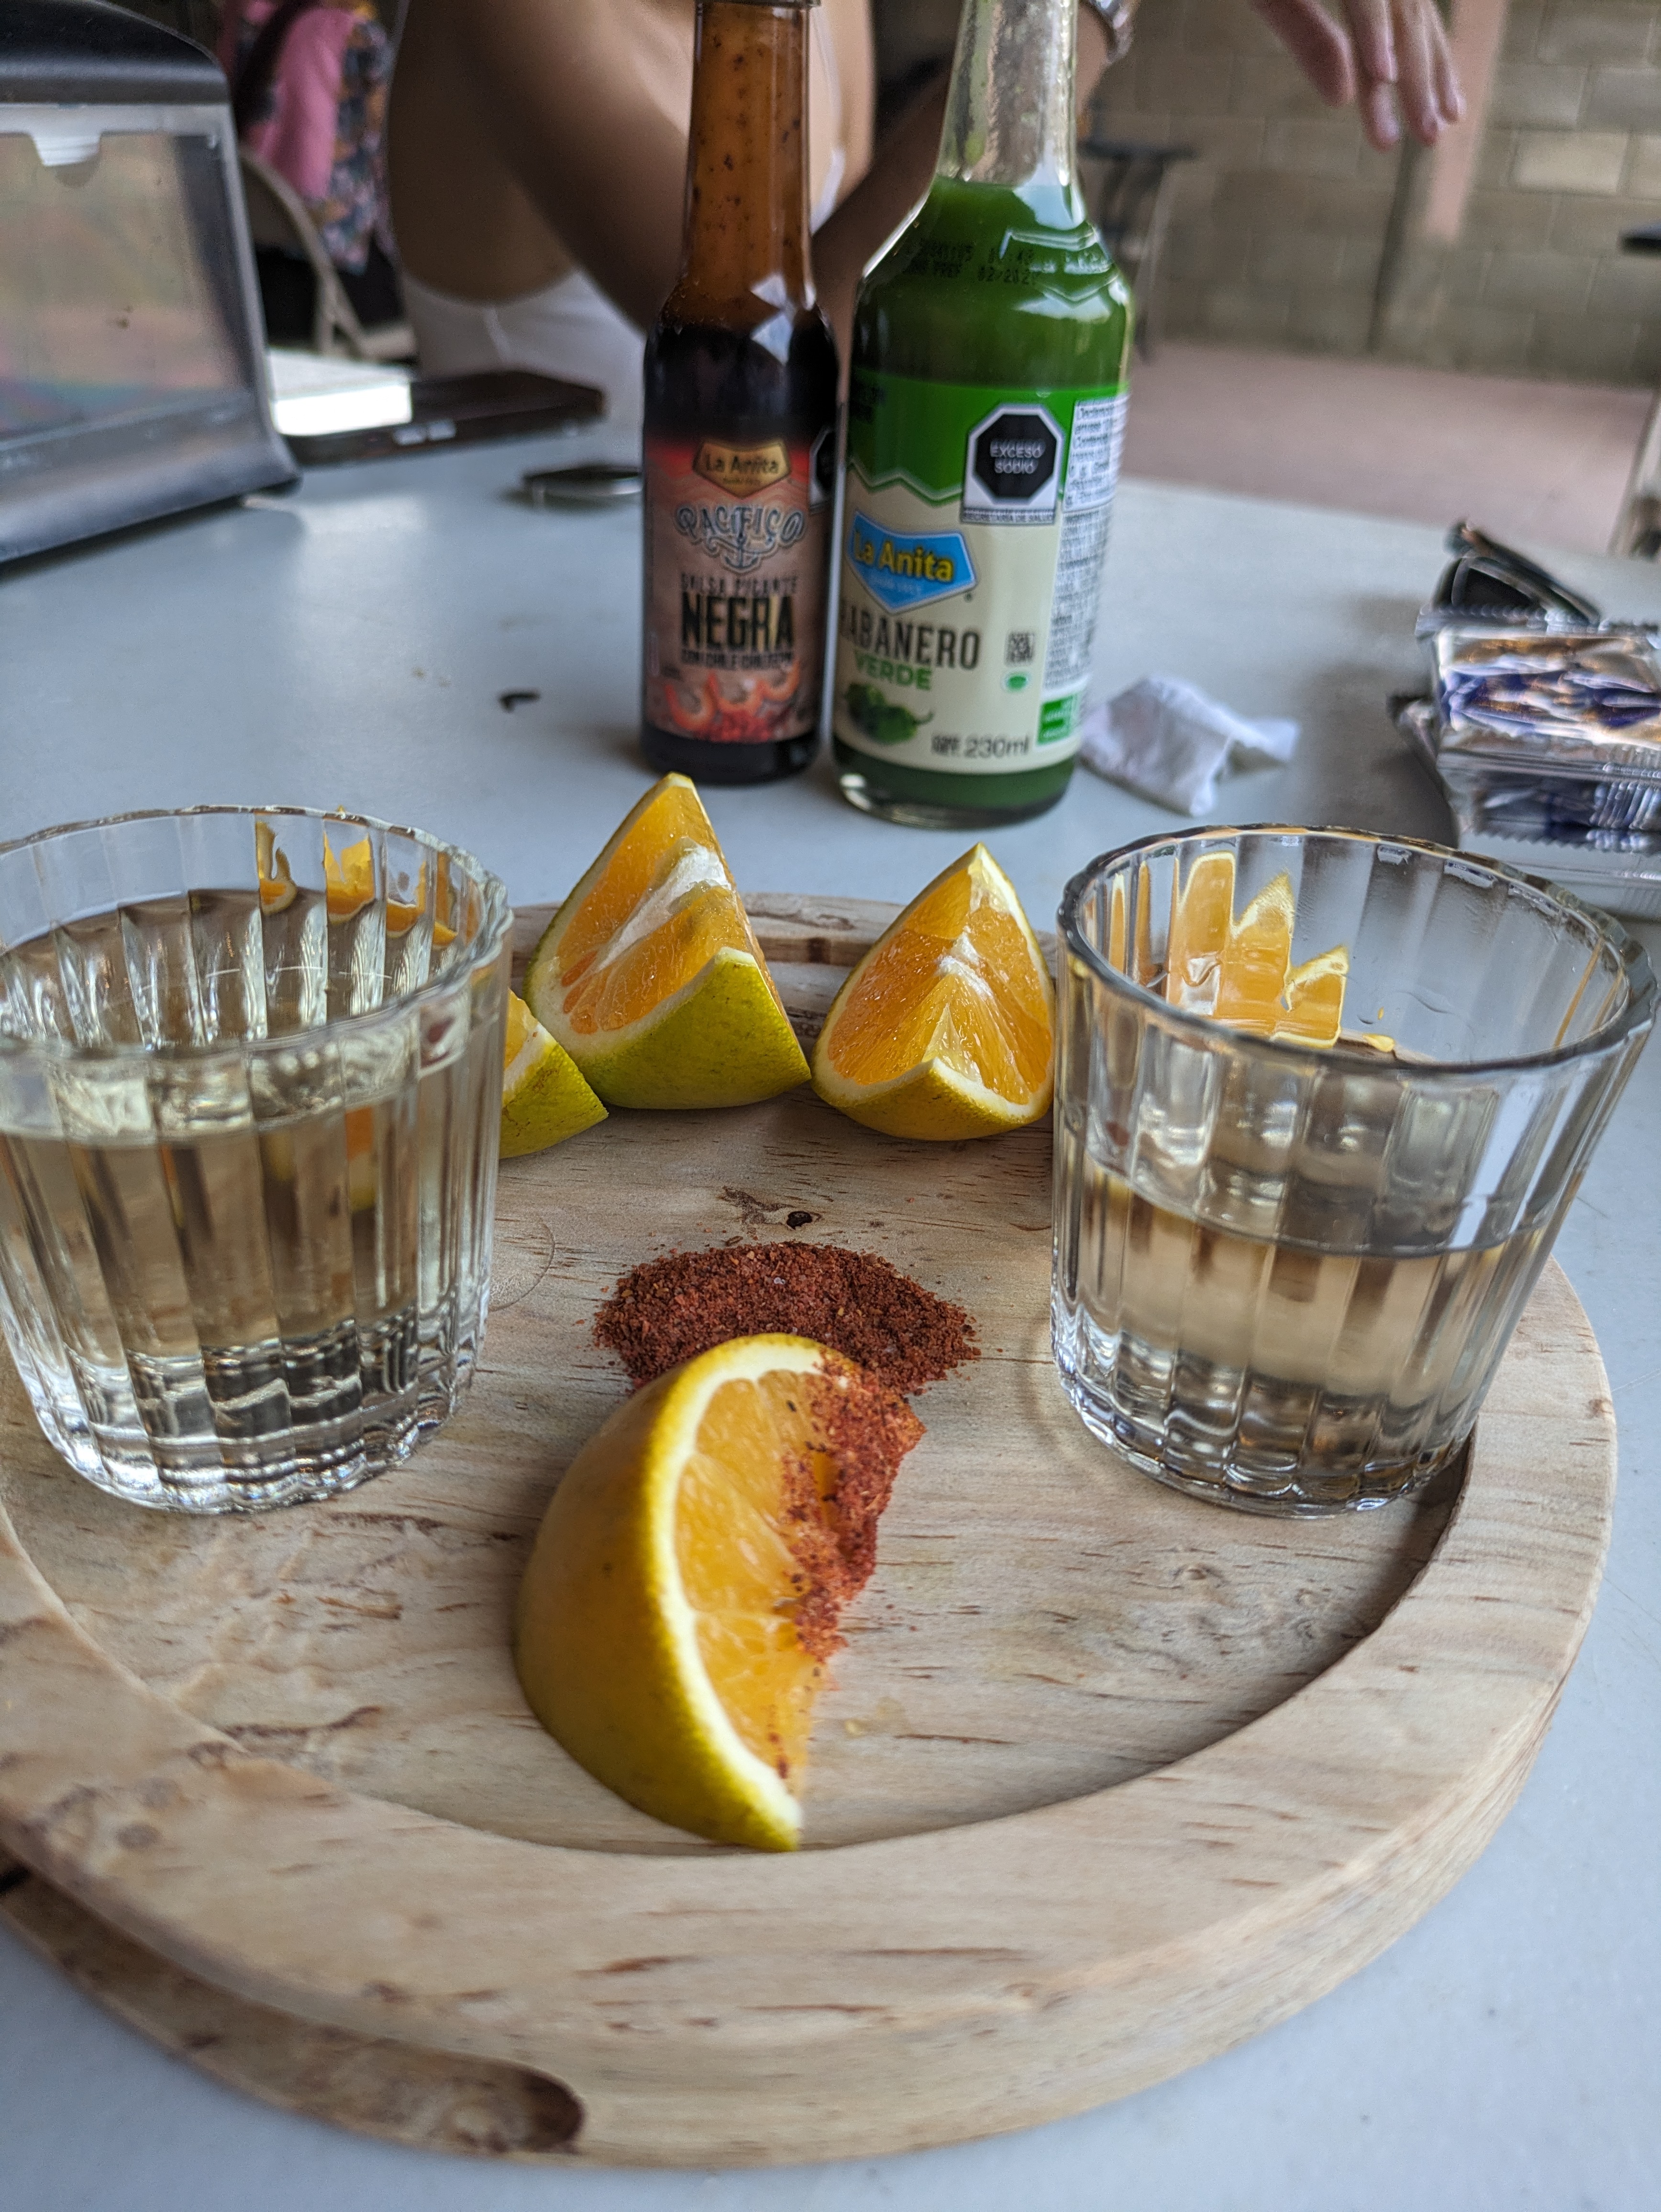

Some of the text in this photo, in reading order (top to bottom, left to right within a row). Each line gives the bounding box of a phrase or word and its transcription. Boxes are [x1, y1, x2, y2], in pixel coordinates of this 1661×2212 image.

[990, 439, 1046, 458] EXCESO
[705, 453, 779, 474] La Anita
[995, 458, 1038, 474] SODIO
[853, 529, 954, 583] La Anita
[681, 593, 794, 651] NEGRA
[854, 650, 932, 691] VERDE
[964, 733, 1030, 759] 230ml
